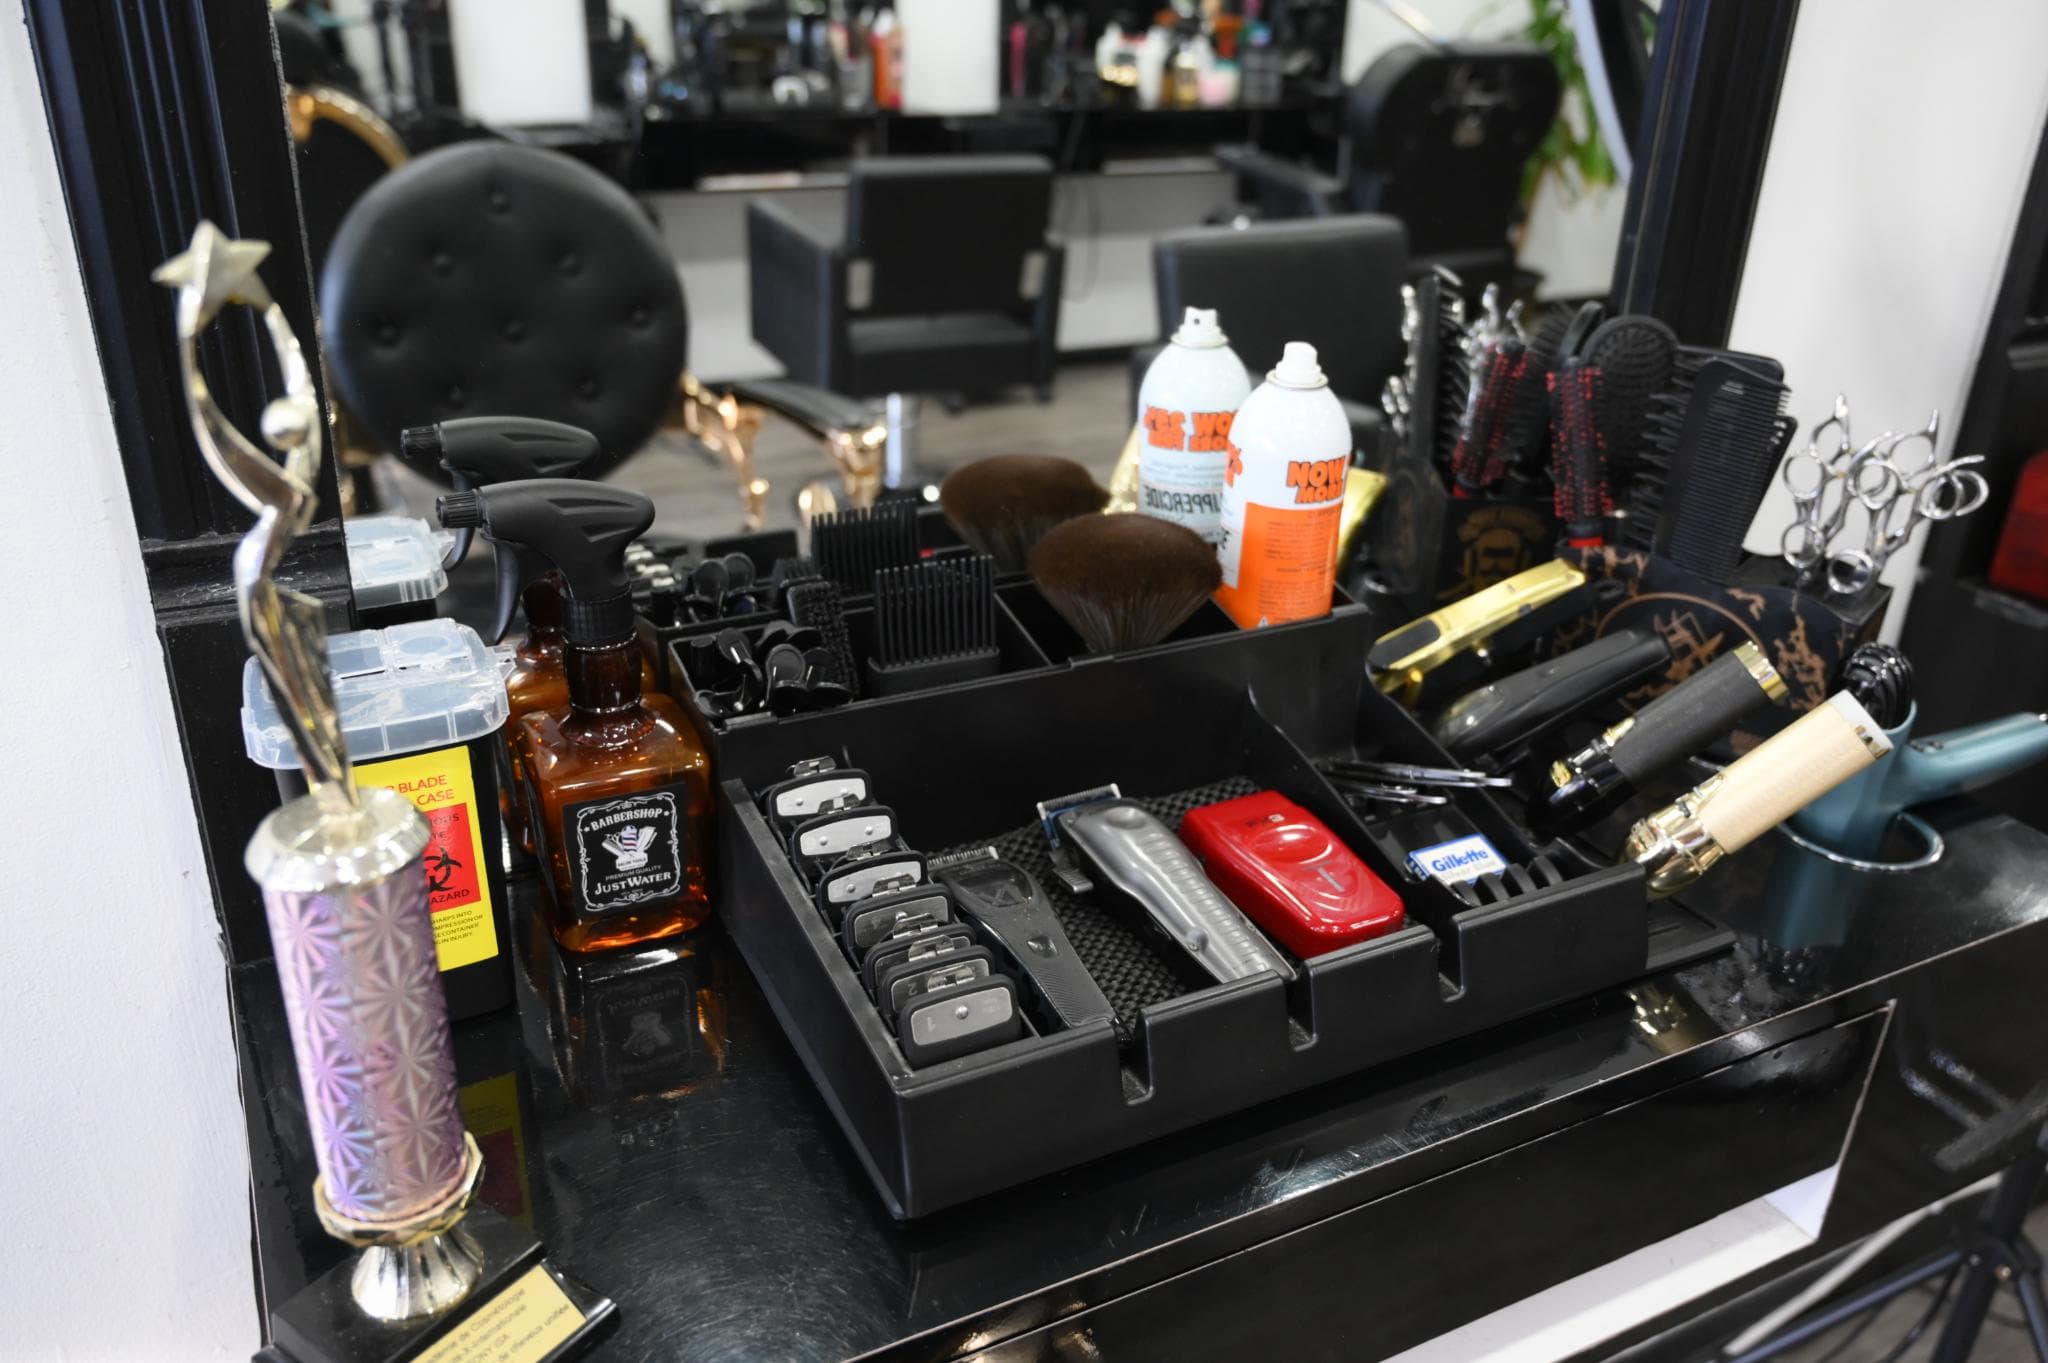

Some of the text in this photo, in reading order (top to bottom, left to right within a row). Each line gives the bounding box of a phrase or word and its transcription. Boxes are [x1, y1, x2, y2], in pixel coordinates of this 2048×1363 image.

[1286, 456, 1345, 488] NOW
[398, 774, 448, 793] BLADE
[416, 788, 455, 805] CASE
[590, 808, 663, 831] BARBERSHOP
[1432, 849, 1489, 871] Gillette
[605, 870, 636, 880] PREMIUM
[636, 864, 662, 875] QUALITY
[431, 889, 470, 904] AZARD
